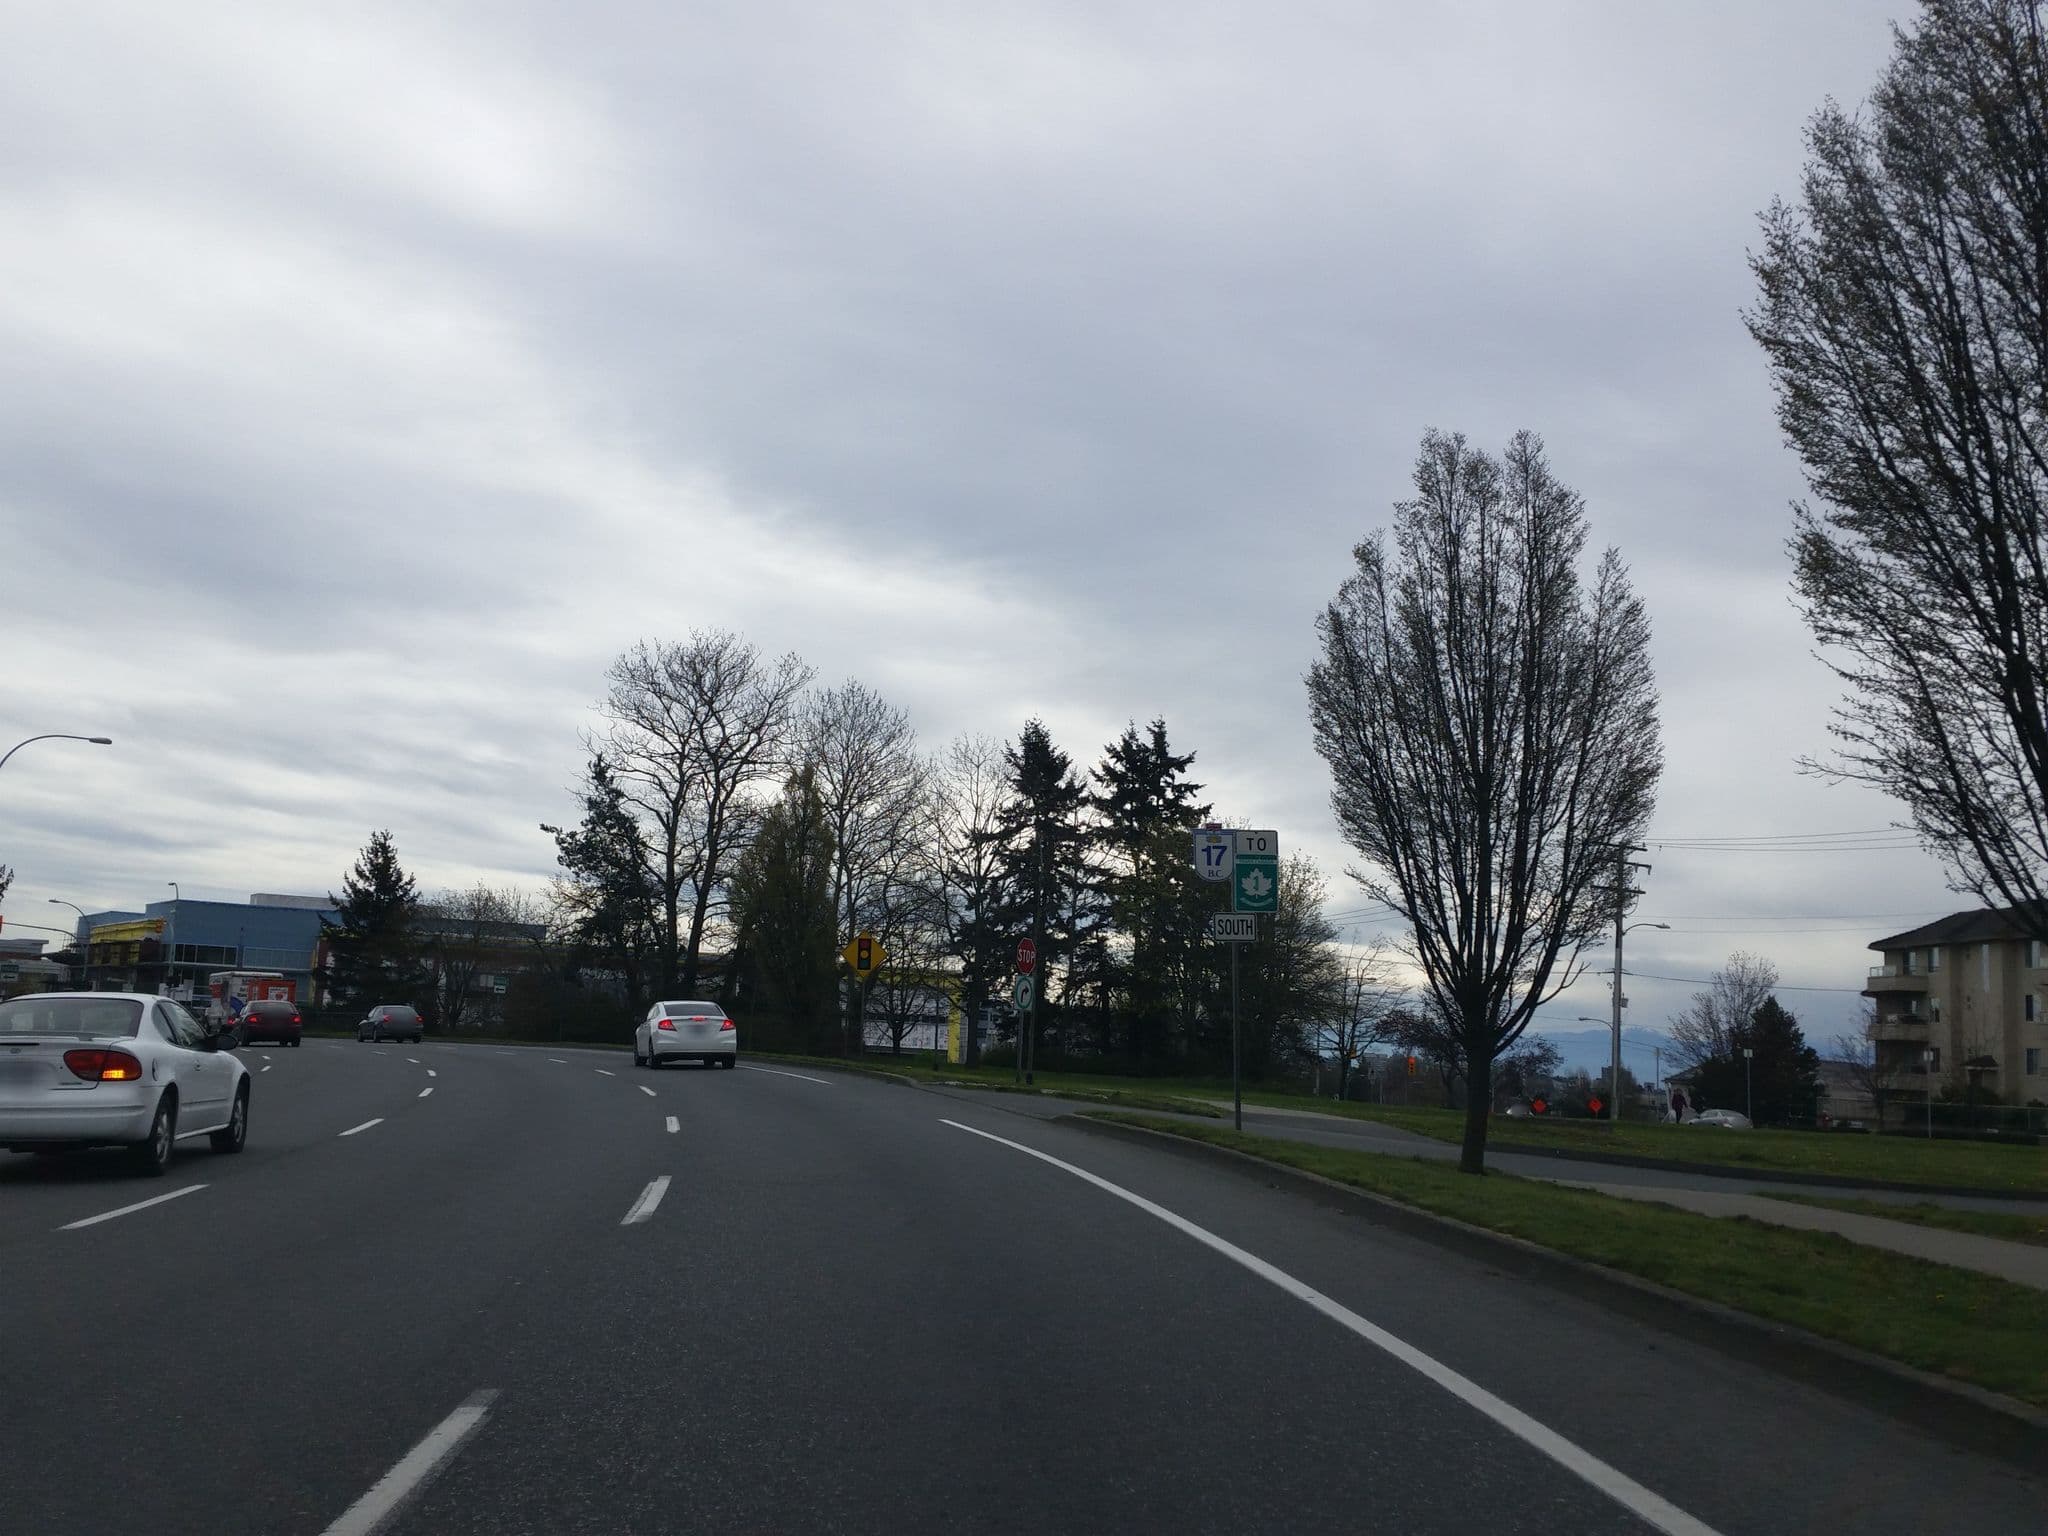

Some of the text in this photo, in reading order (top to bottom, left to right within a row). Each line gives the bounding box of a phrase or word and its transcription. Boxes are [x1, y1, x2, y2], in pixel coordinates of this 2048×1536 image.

[1246, 837, 1266, 851] TO
[1201, 845, 1228, 866] 17
[1253, 875, 1259, 890] 1
[1217, 918, 1253, 936] SOUTH
[1018, 949, 1036, 964] STOP
